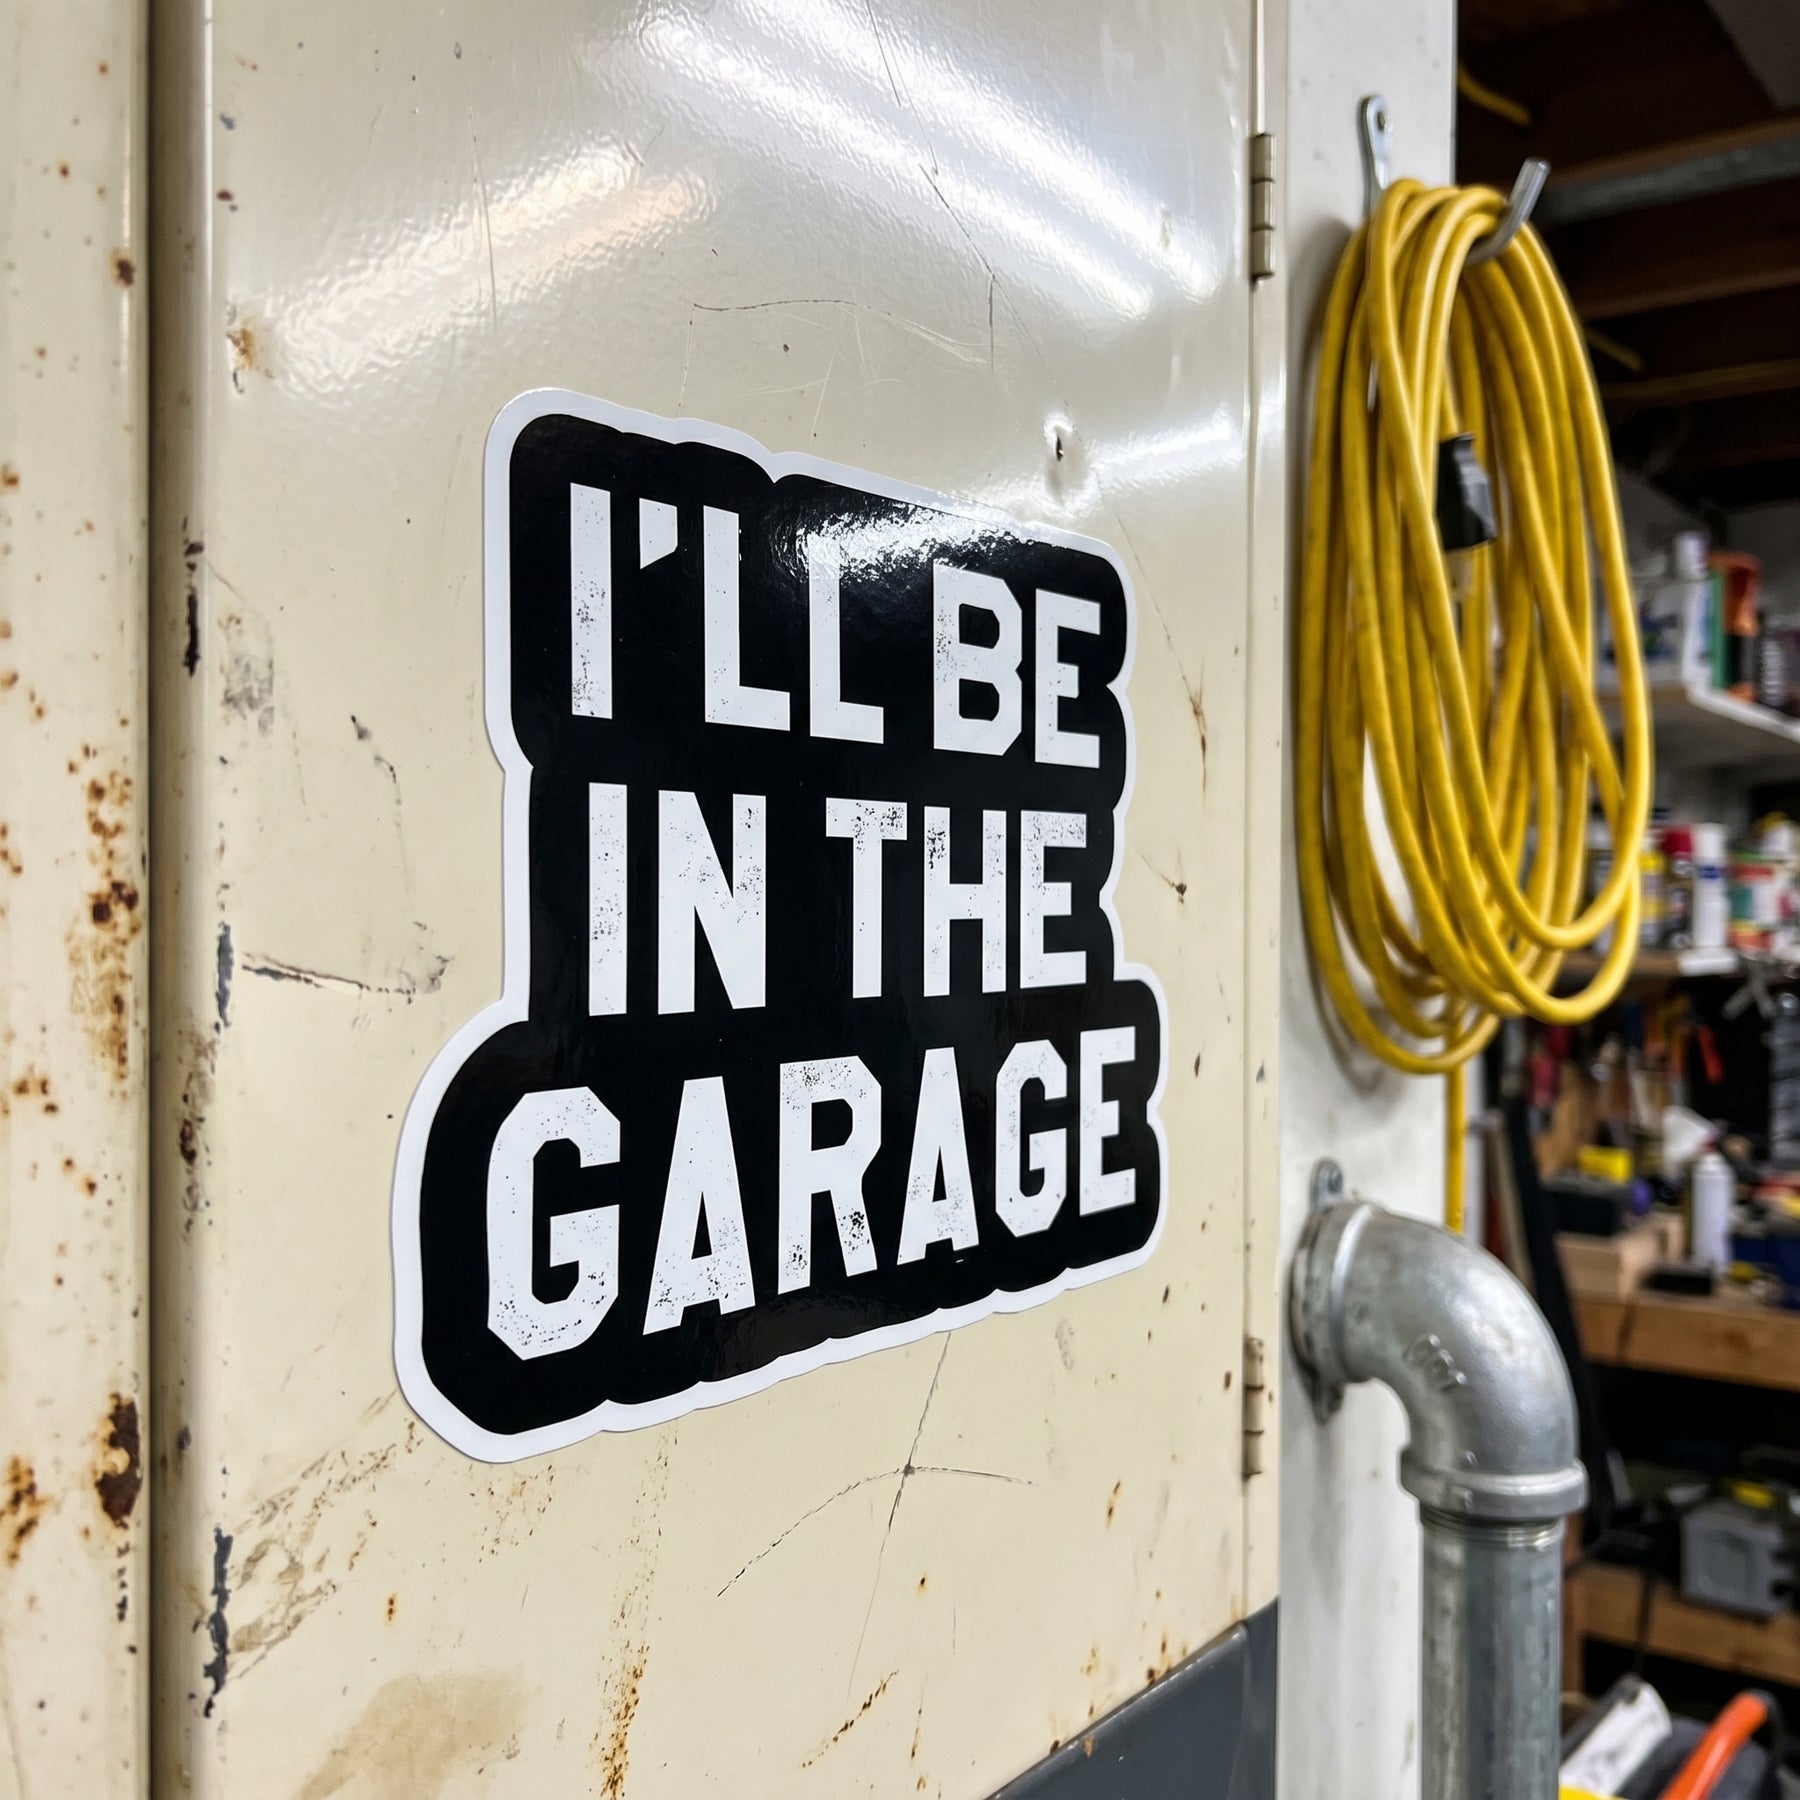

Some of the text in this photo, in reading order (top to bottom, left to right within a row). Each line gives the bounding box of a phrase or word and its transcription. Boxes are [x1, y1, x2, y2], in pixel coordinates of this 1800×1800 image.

[571, 483, 1101, 768] I'LL BE
[588, 783, 1087, 1017] IN THE
[486, 1026, 1136, 1361] GARAGE
